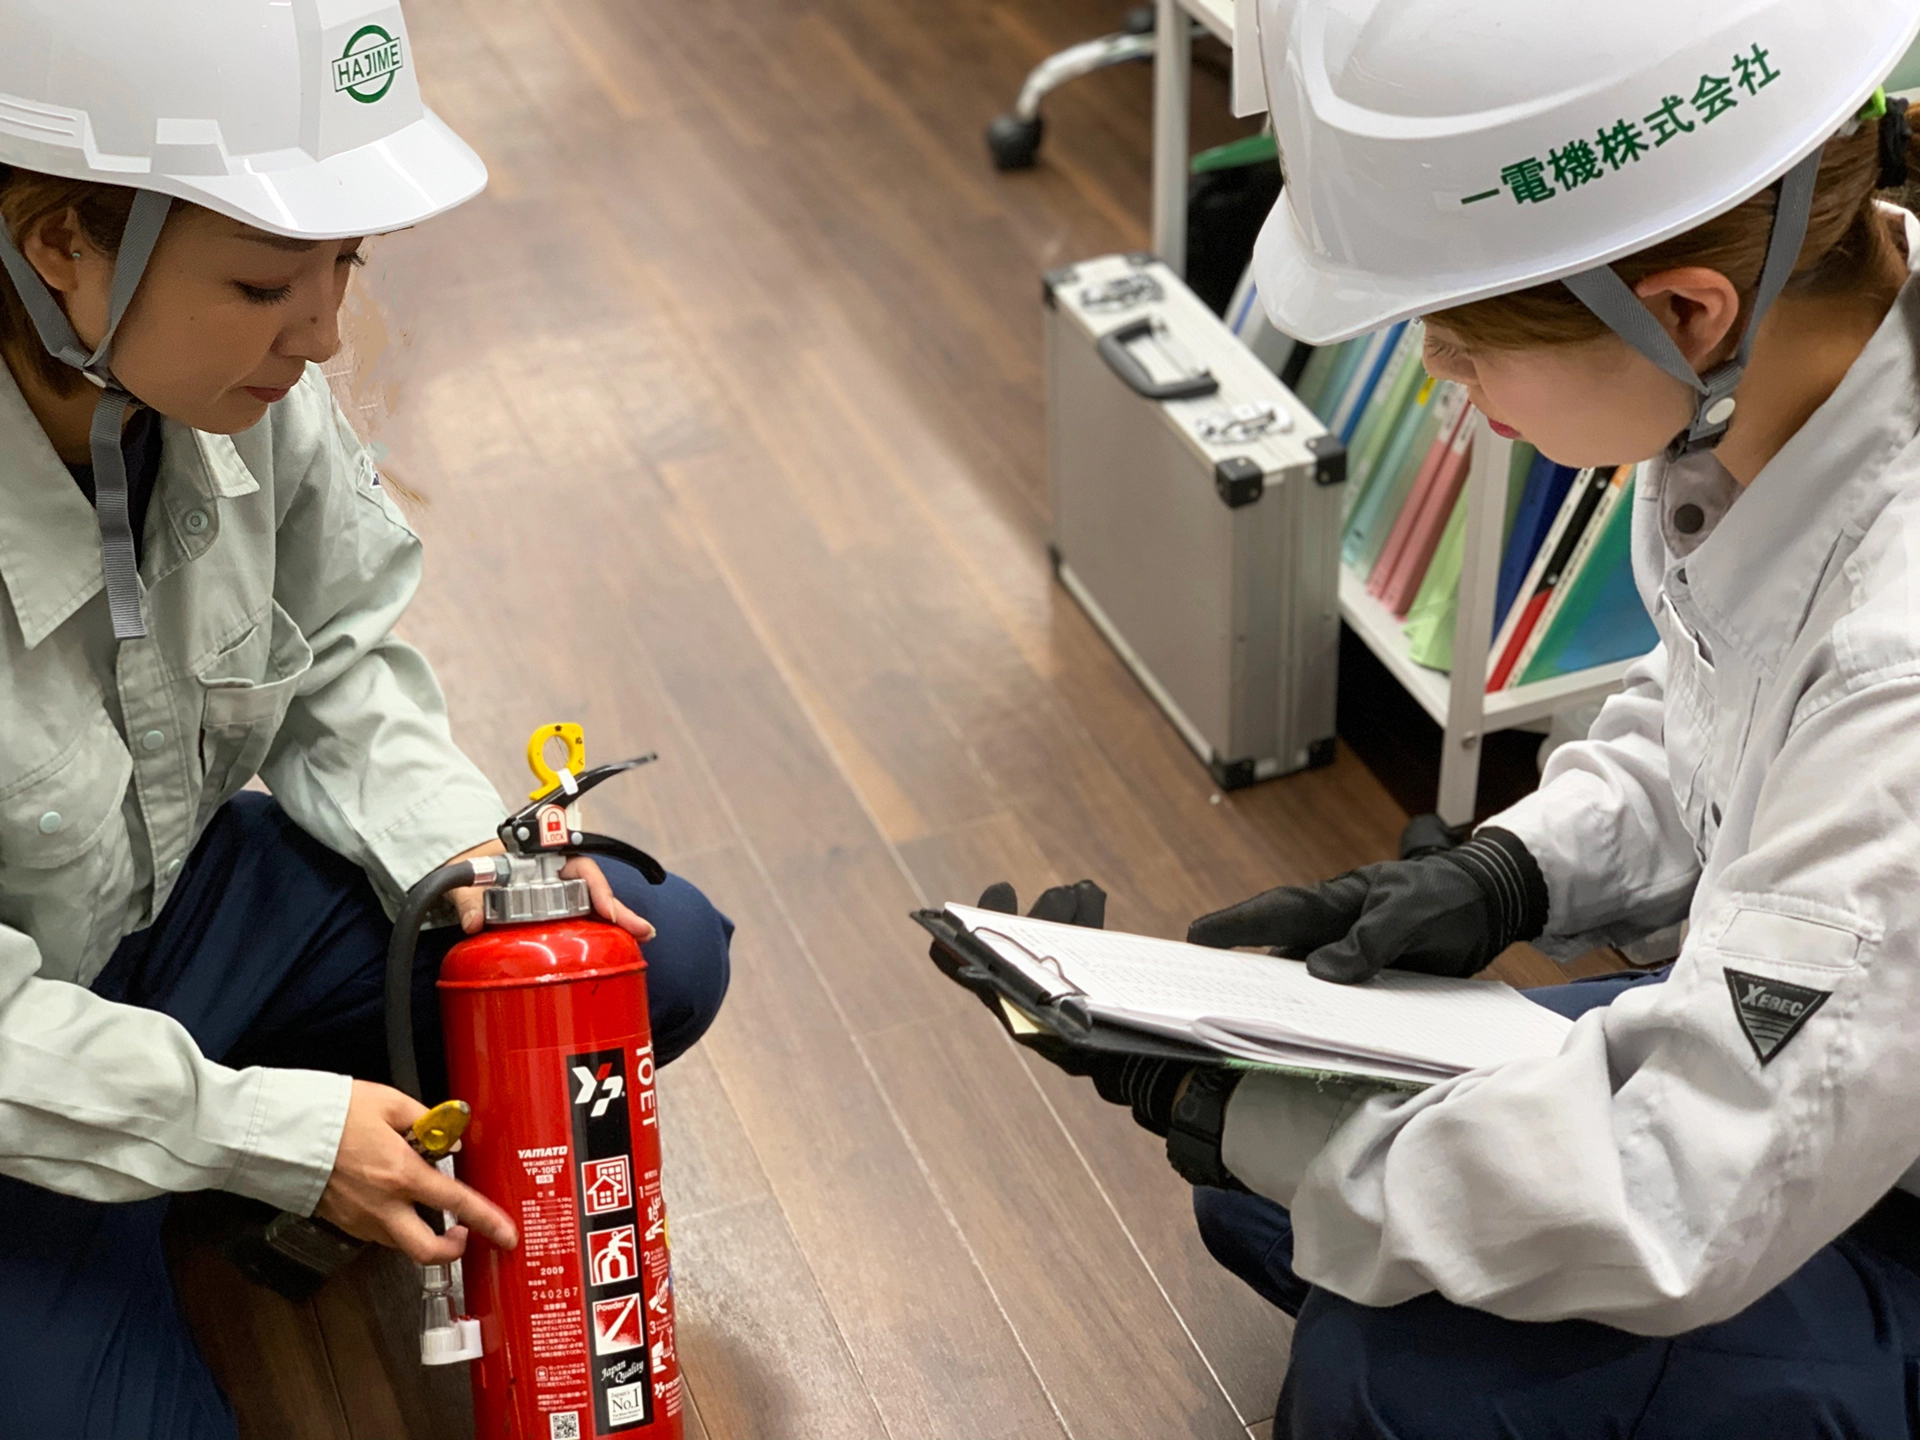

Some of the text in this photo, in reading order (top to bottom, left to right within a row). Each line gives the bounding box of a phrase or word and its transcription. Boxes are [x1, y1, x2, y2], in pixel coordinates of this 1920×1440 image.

[337, 43, 400, 86] HAJIME
[1460, 42, 1781, 206] 一電機株式会社
[545, 833, 565, 842] LOCK
[517, 1145, 568, 1159] YAMATO
[525, 1164, 563, 1175] YP-10ET
[644, 1251, 651, 1265] 2
[540, 1265, 564, 1276] 2009
[596, 1301, 626, 1313] Powder
[649, 1320, 657, 1335] 3
[601, 1360, 627, 1381] Japan
[615, 1361, 644, 1383] Quality
